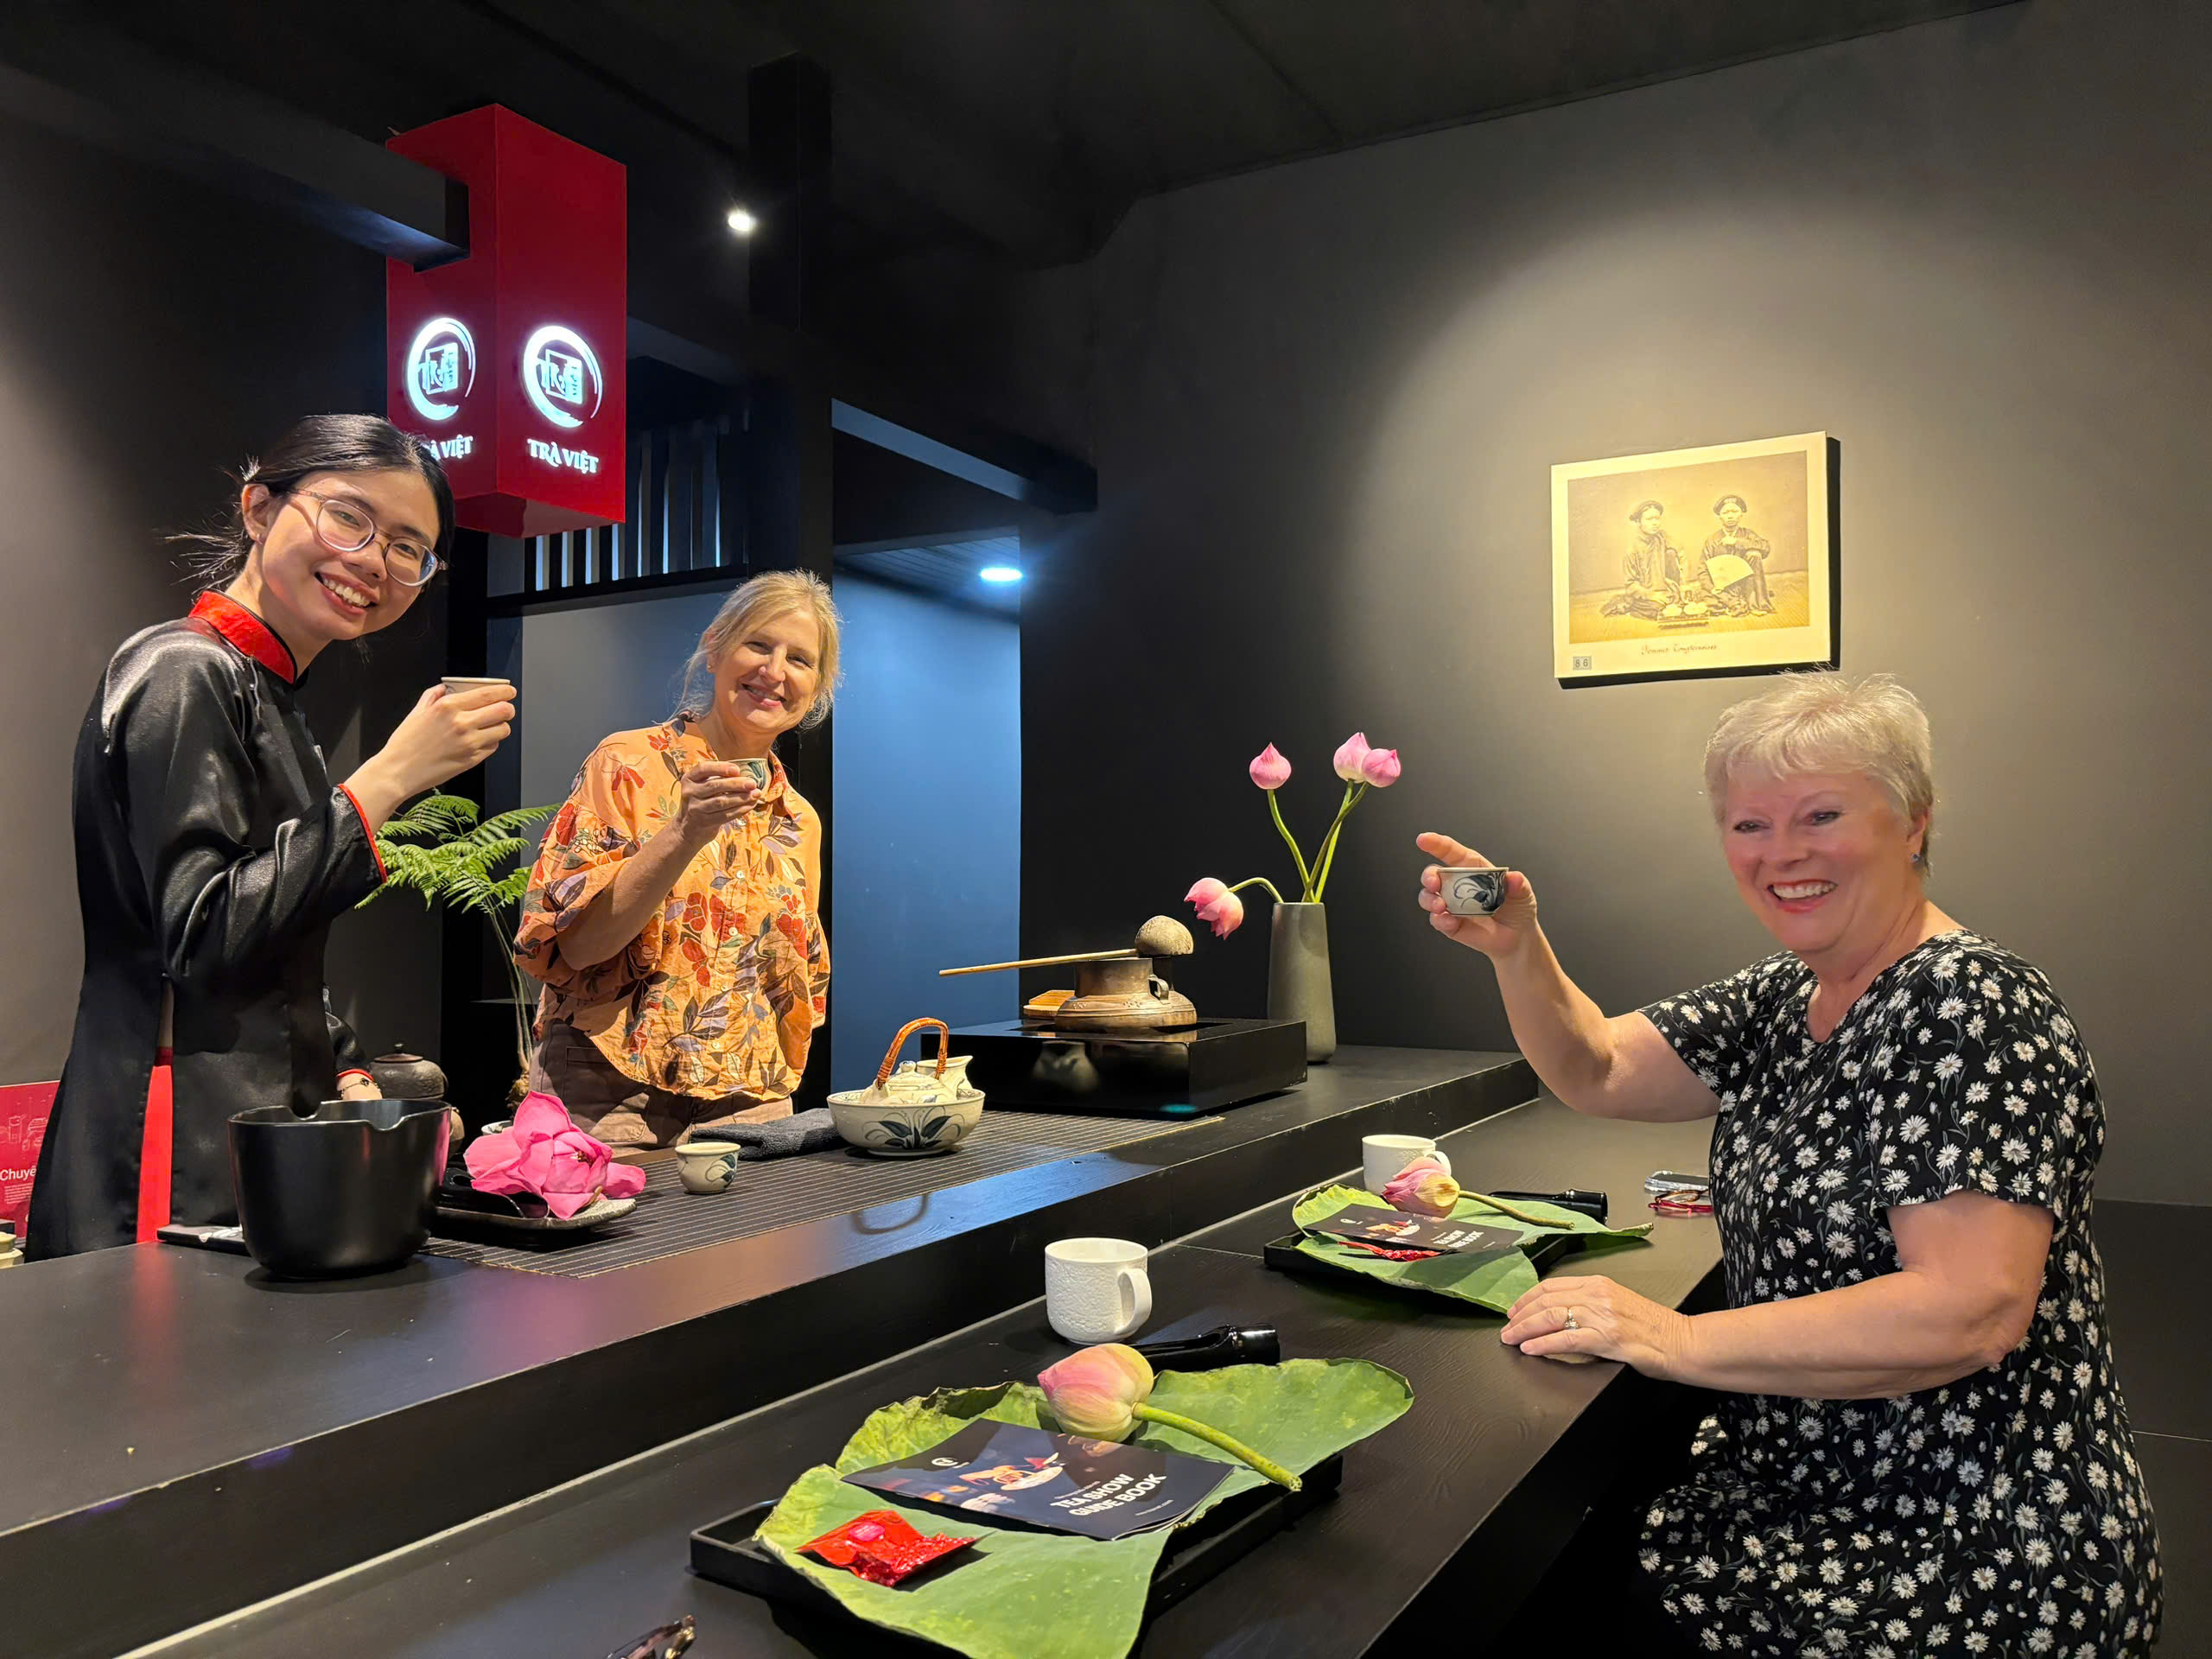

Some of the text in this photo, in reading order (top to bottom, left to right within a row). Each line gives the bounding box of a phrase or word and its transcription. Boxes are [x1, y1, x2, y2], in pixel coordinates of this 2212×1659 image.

[440, 434, 474, 459] VIỆT
[527, 438, 599, 474] TRÀ VIỆT
[1049, 1497, 1092, 1509] TEA
[1083, 1473, 1135, 1500] SHOW
[1068, 1499, 1125, 1516] GUIDE
[1115, 1473, 1167, 1503] BOOK
